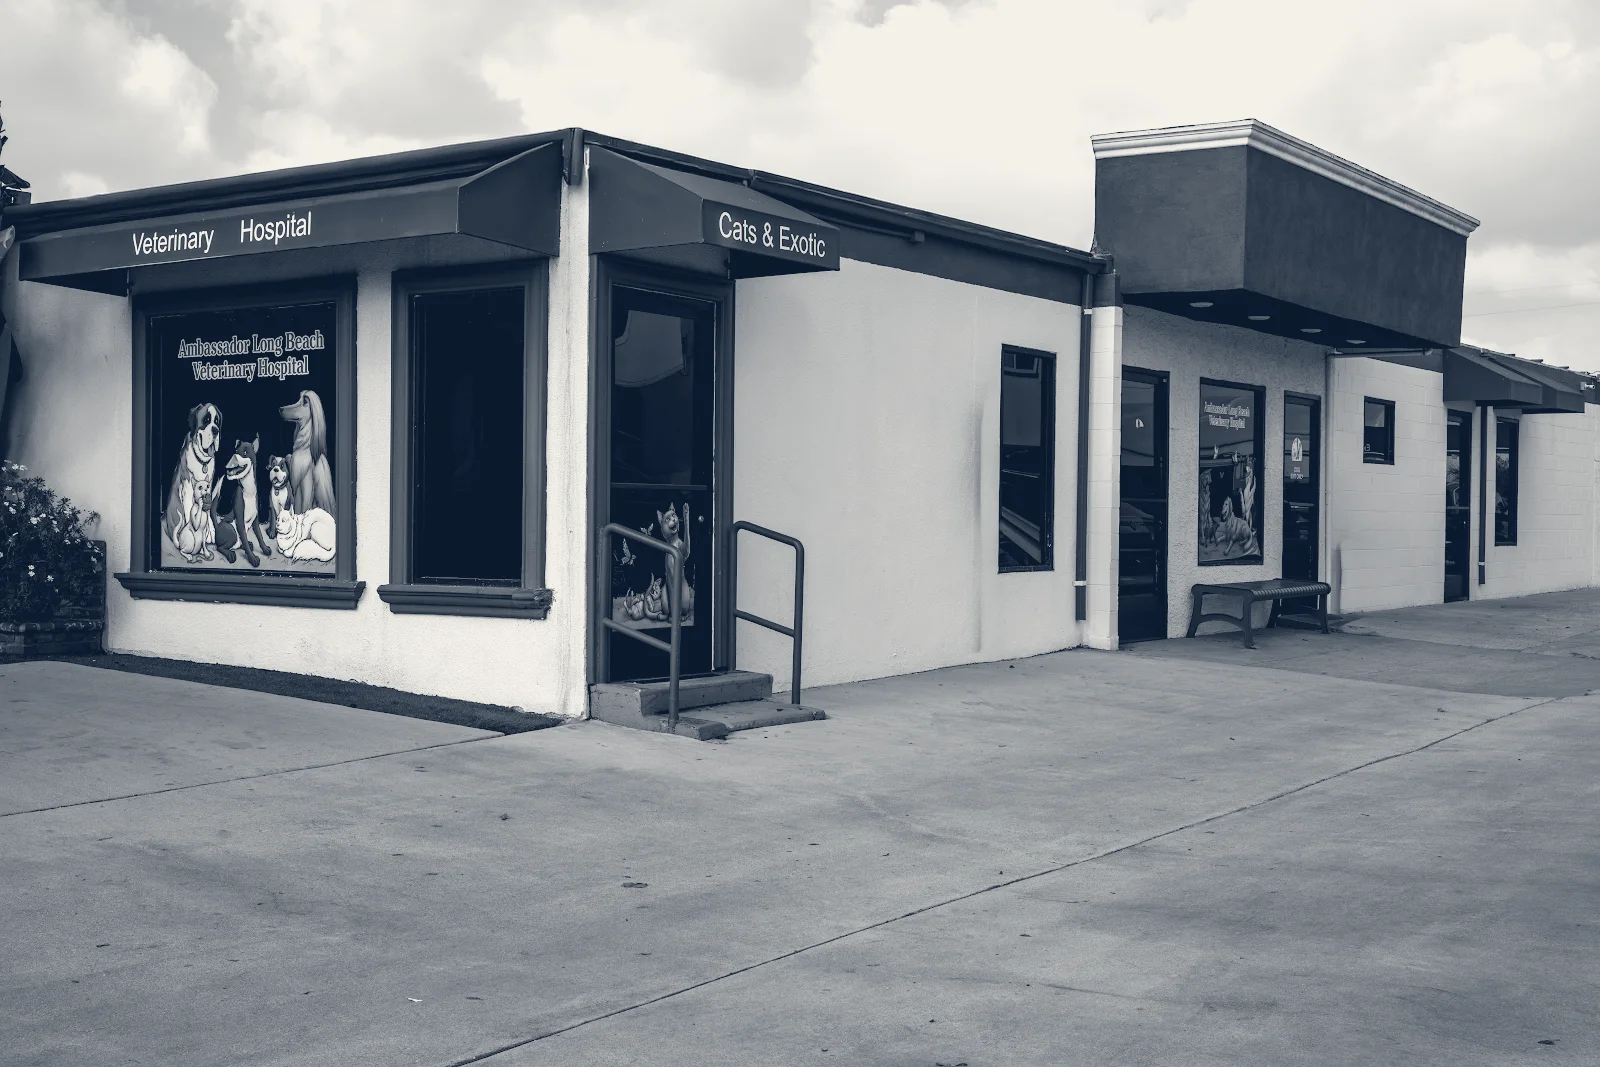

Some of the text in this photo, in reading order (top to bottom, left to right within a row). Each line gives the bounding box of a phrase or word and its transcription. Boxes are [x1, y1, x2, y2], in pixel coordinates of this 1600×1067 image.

[132, 210, 312, 256] Veterinary Hospital
[719, 211, 826, 258] Cats & Exotic
[178, 329, 325, 359] Ambassador Long Beach
[192, 354, 310, 383] Veterinary Hospital
